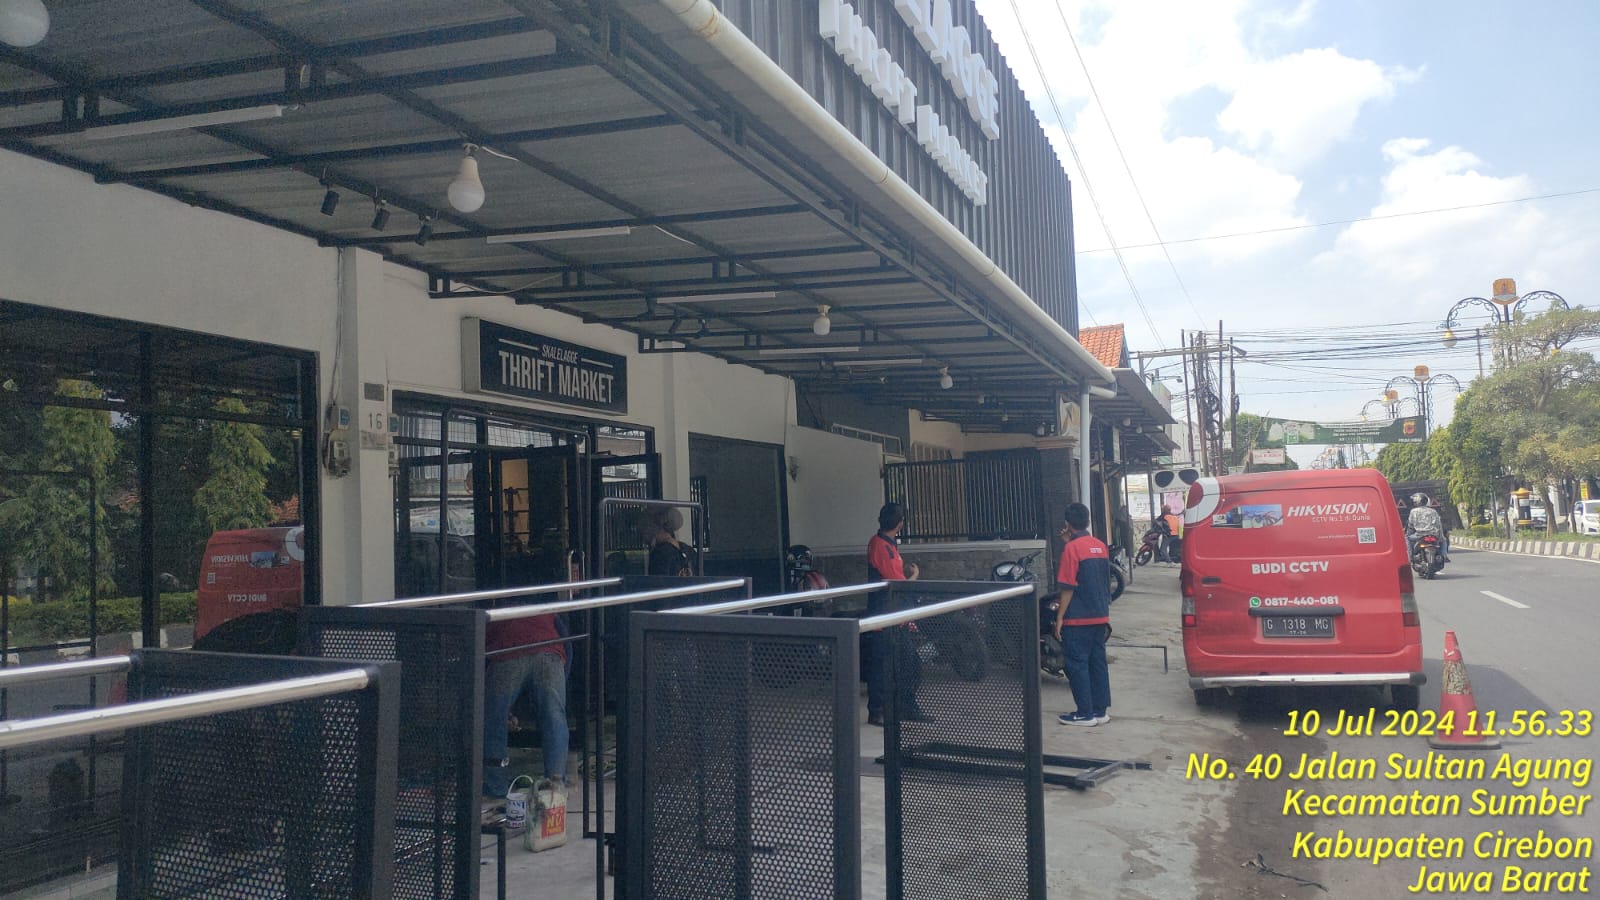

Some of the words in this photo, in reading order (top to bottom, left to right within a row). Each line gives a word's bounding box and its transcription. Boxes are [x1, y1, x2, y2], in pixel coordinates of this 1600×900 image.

[499, 351, 554, 393] THRIFT
[559, 364, 613, 403] MARKET
[368, 413, 382, 430] 16
[1287, 503, 1368, 517] HIKVISION
[1251, 562, 1286, 574] BUDI
[1289, 561, 1329, 573] CCTV
[1264, 596, 1339, 606] 0817-440-081
[1267, 619, 1273, 630] G
[1282, 618, 1306, 630] 1318
[1314, 618, 1329, 629] MG
